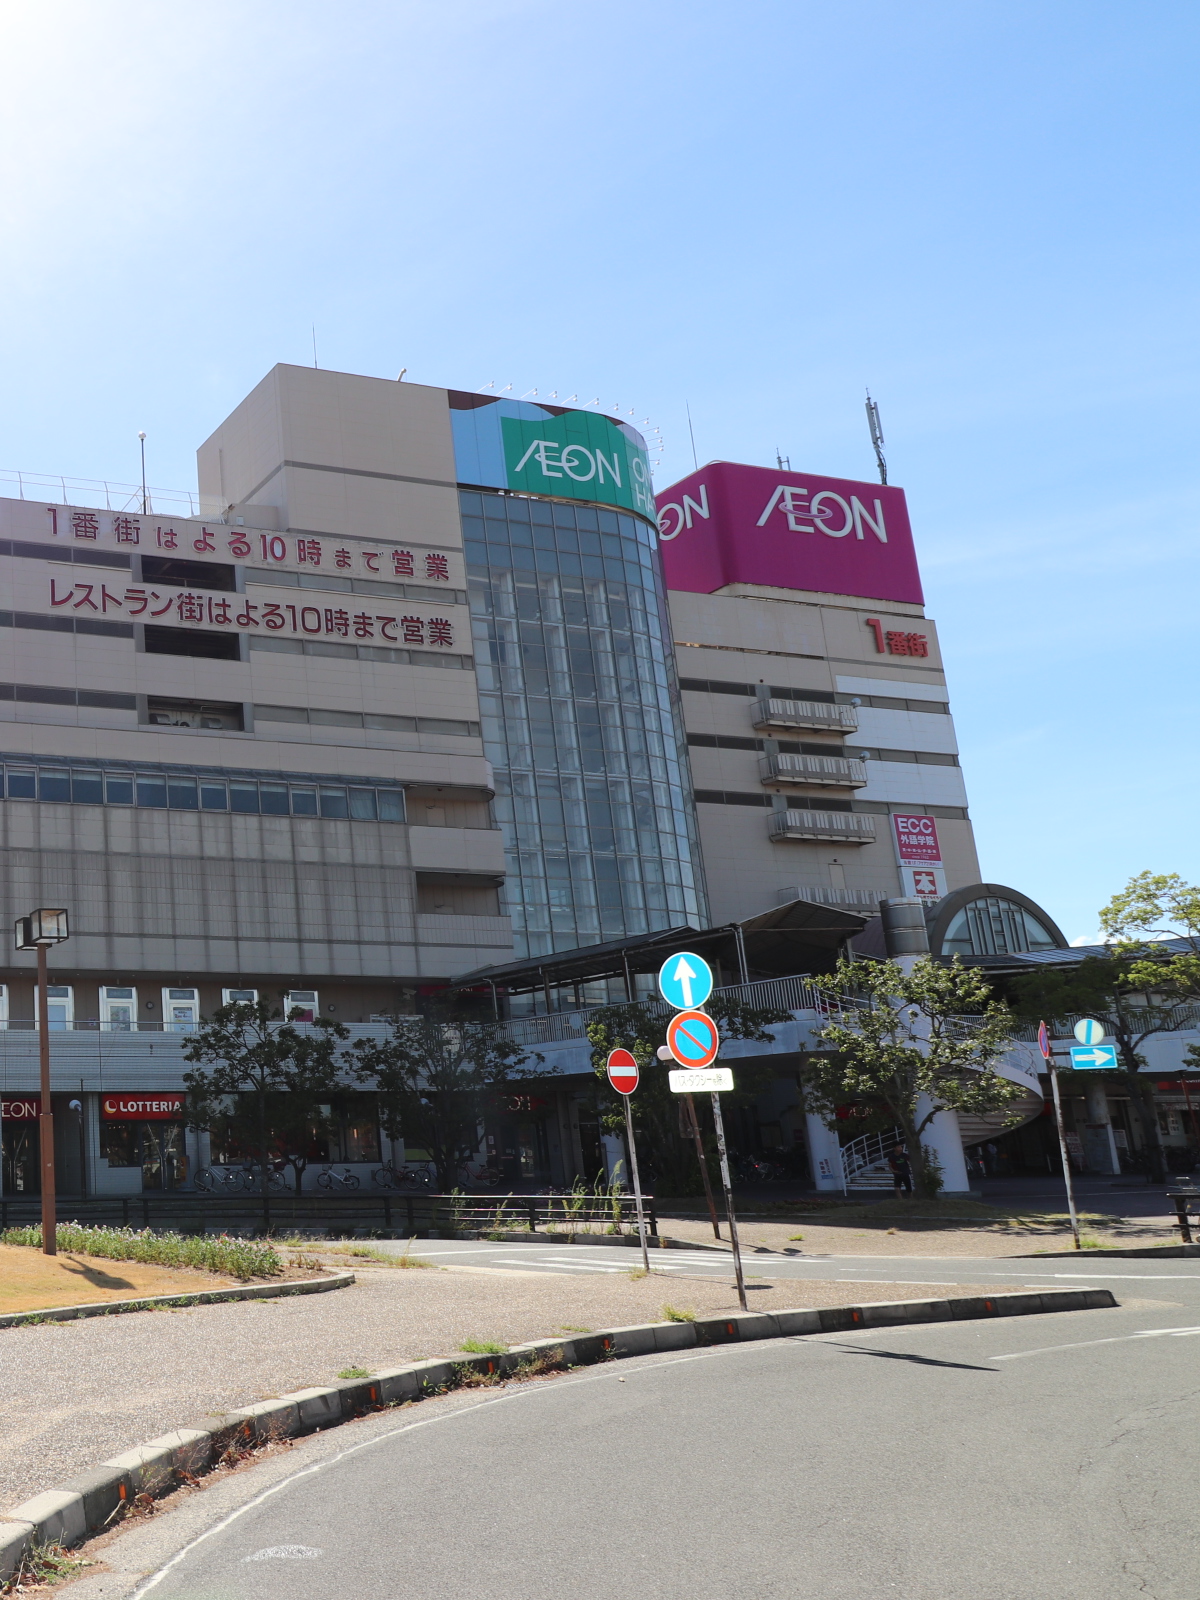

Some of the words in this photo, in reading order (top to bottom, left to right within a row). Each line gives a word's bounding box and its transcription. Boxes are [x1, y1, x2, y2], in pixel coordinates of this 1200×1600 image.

[50, 578, 454, 648] レストラン街はよる10時まで営業
[866, 618, 929, 657] 1番街
[897, 817, 933, 834] ECC
[901, 834, 935, 846] 外語学院
[119, 1101, 183, 1112] LOTTERIA
